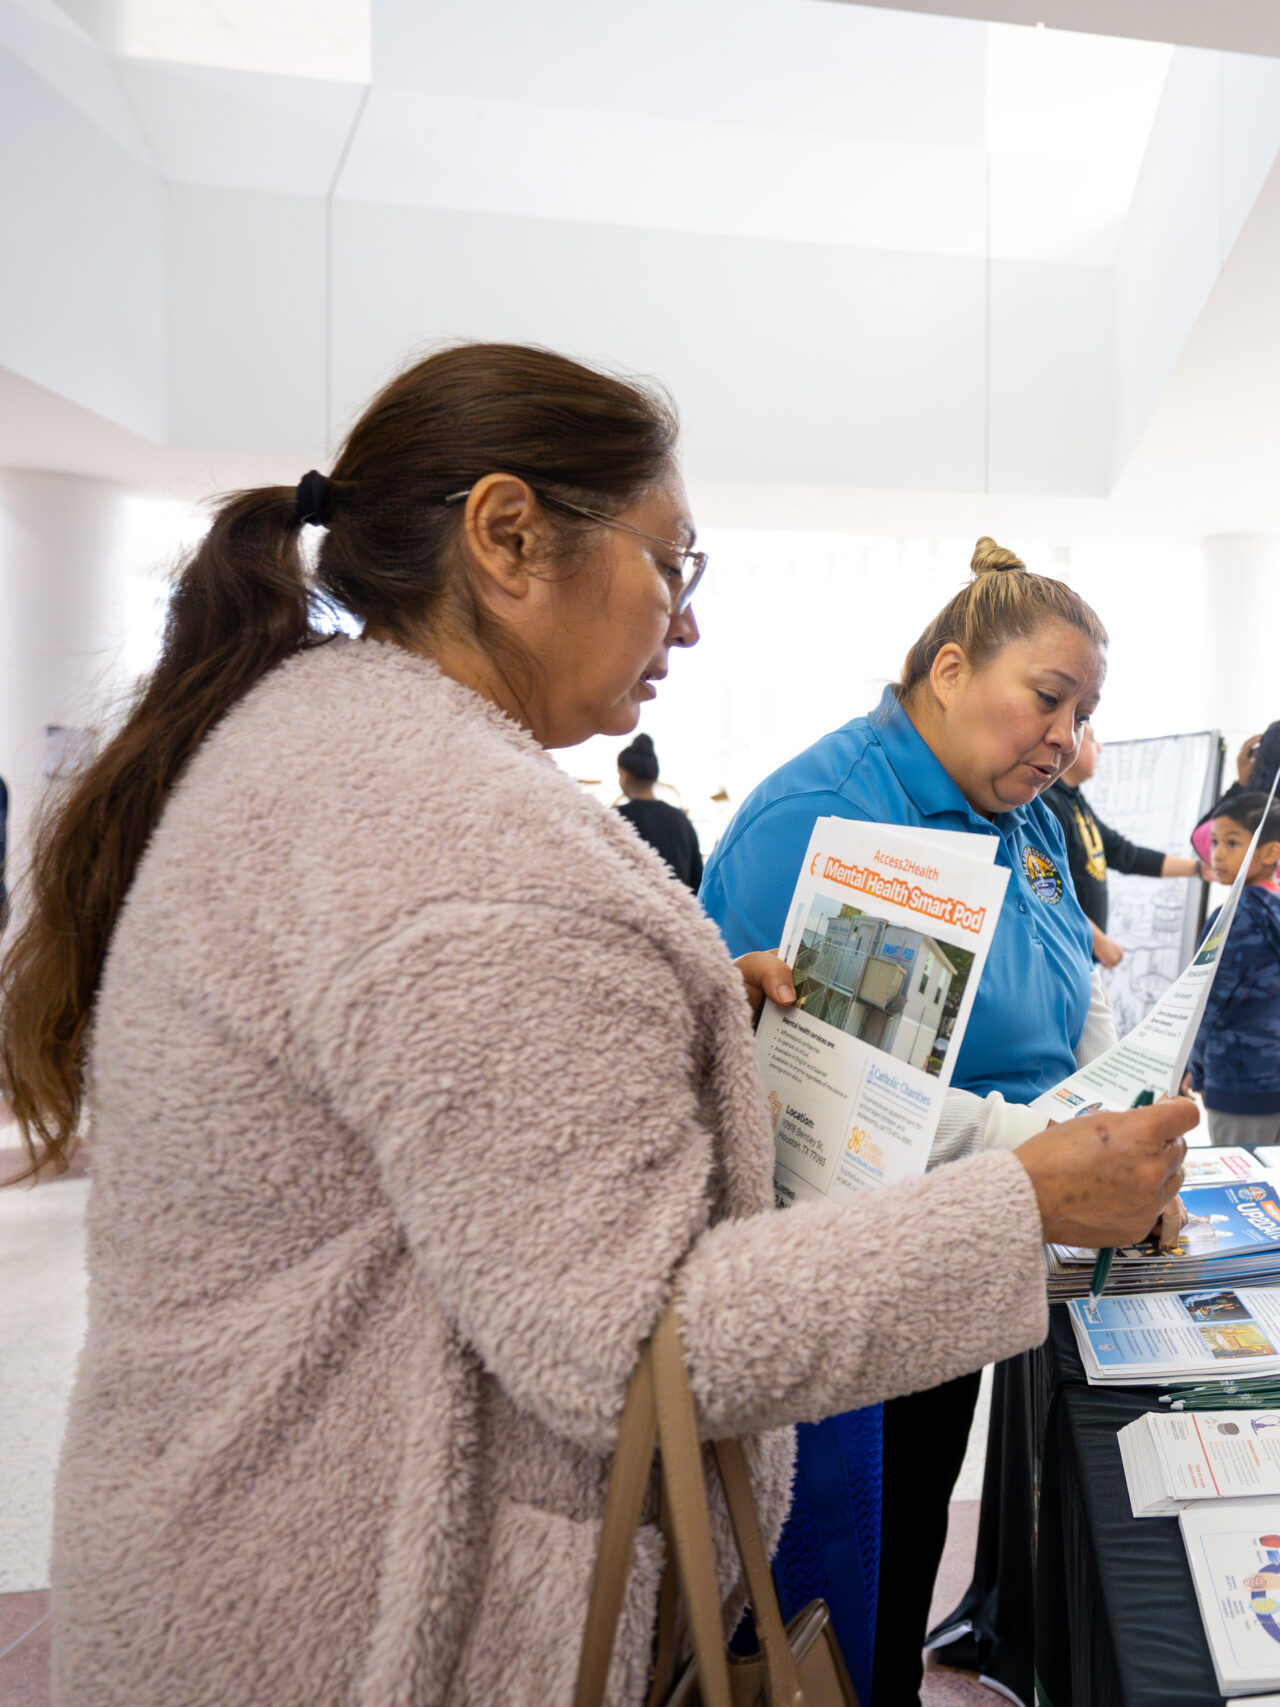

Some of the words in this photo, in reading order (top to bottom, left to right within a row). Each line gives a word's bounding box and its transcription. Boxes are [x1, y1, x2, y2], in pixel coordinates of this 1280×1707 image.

[873, 850, 939, 882] Access2Health
[826, 860, 866, 889] Mental
[866, 872, 909, 905] Health
[910, 886, 952, 920] Smart
[952, 904, 985, 932] Pod
